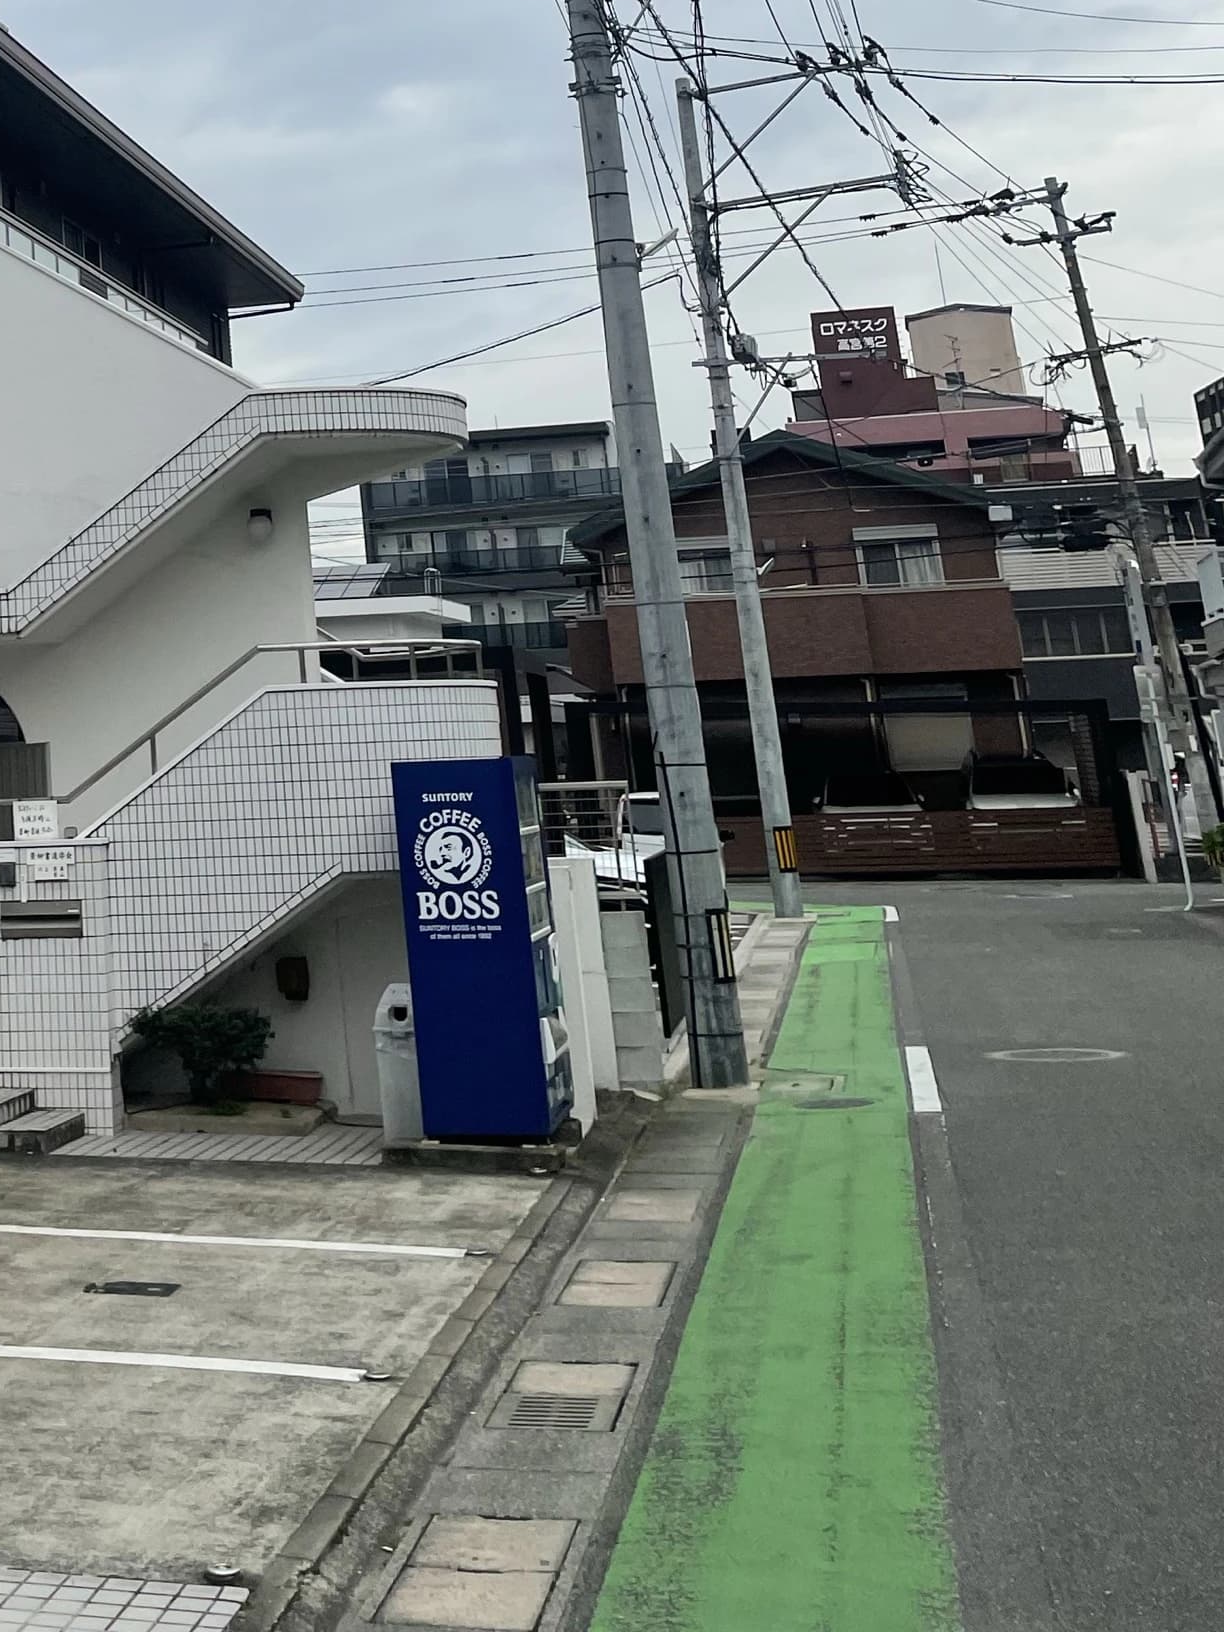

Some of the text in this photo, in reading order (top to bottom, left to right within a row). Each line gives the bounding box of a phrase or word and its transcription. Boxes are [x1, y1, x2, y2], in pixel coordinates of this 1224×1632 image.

[820, 318, 887, 336] ロマネスク
[421, 791, 473, 803] SUNTORY
[419, 808, 482, 833] COFFEE
[416, 890, 500, 920] BOSS
